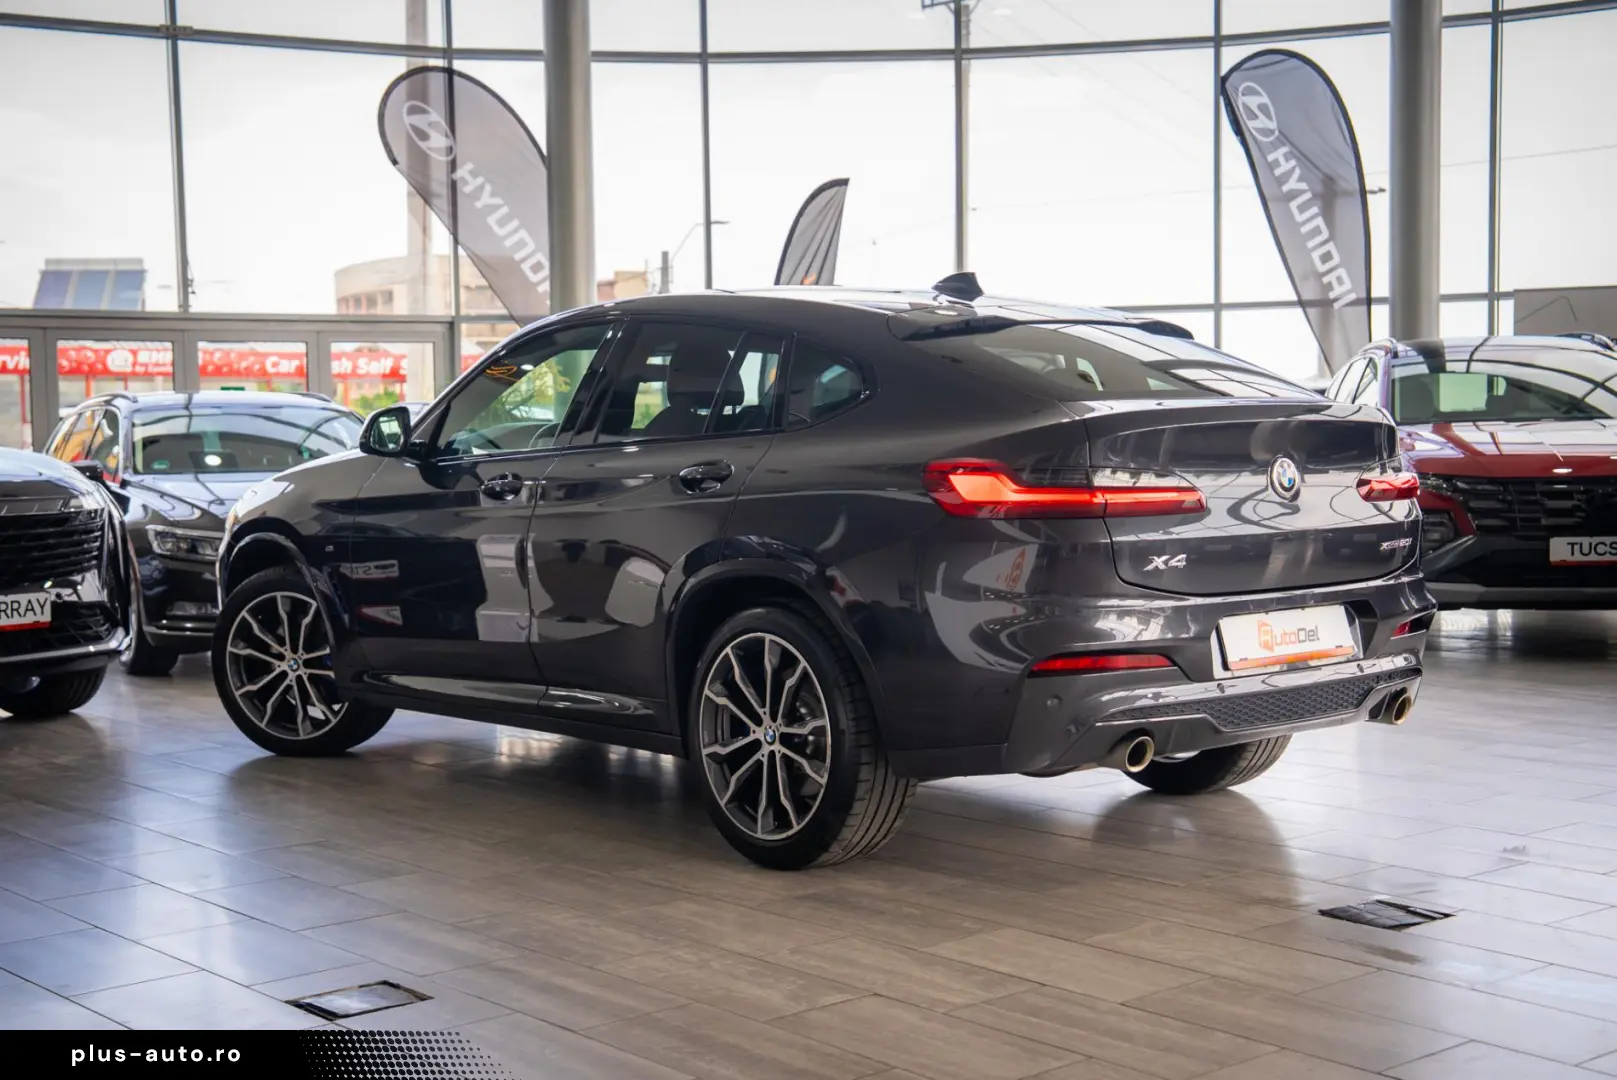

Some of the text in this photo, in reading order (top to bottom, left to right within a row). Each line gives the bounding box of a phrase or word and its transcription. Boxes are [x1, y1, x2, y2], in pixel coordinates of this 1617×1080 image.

[451, 161, 550, 306] HYUND
[1267, 146, 1357, 310] HYUNDAI
[265, 355, 300, 374] Car
[1566, 541, 1617, 557] TUCS
[1143, 553, 1188, 572] X4
[0, 597, 48, 620] RRAY
